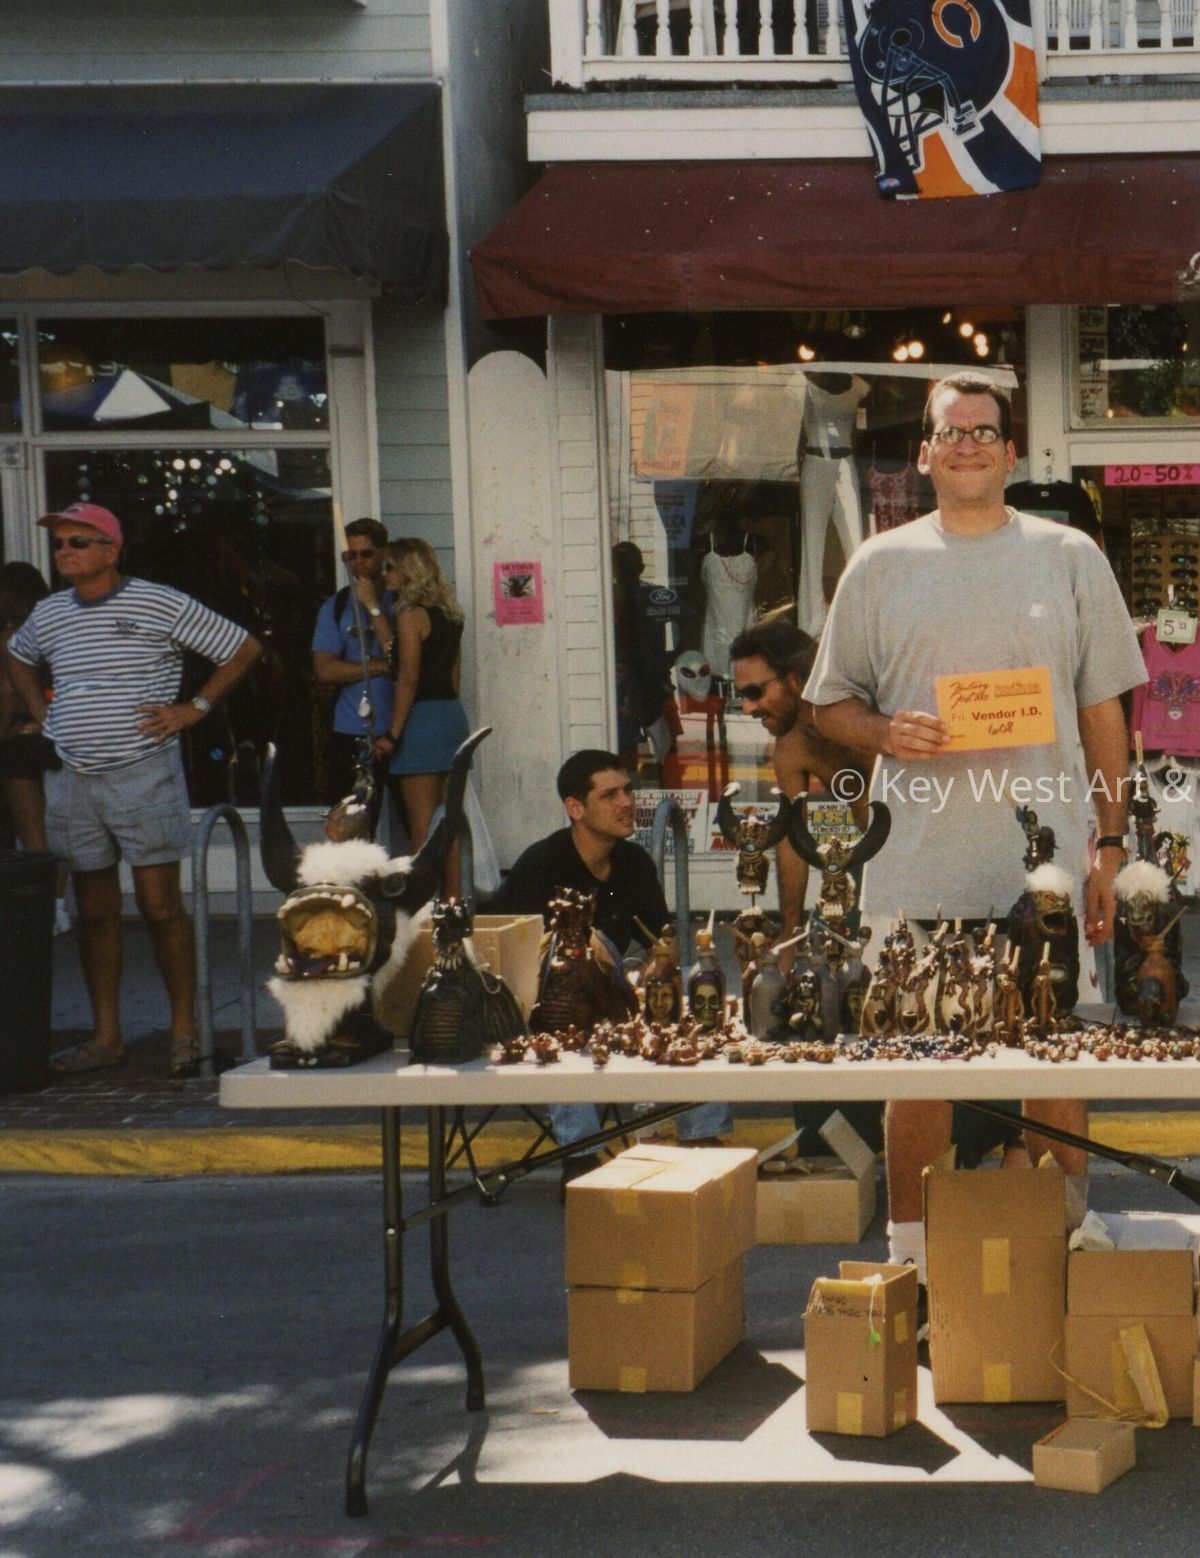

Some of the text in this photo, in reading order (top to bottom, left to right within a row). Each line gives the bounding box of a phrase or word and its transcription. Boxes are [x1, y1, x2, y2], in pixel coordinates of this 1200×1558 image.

[1114, 465, 1194, 484] 20-50%
[972, 708, 1017, 722] Vendor
[1020, 705, 1043, 718] I.D.
